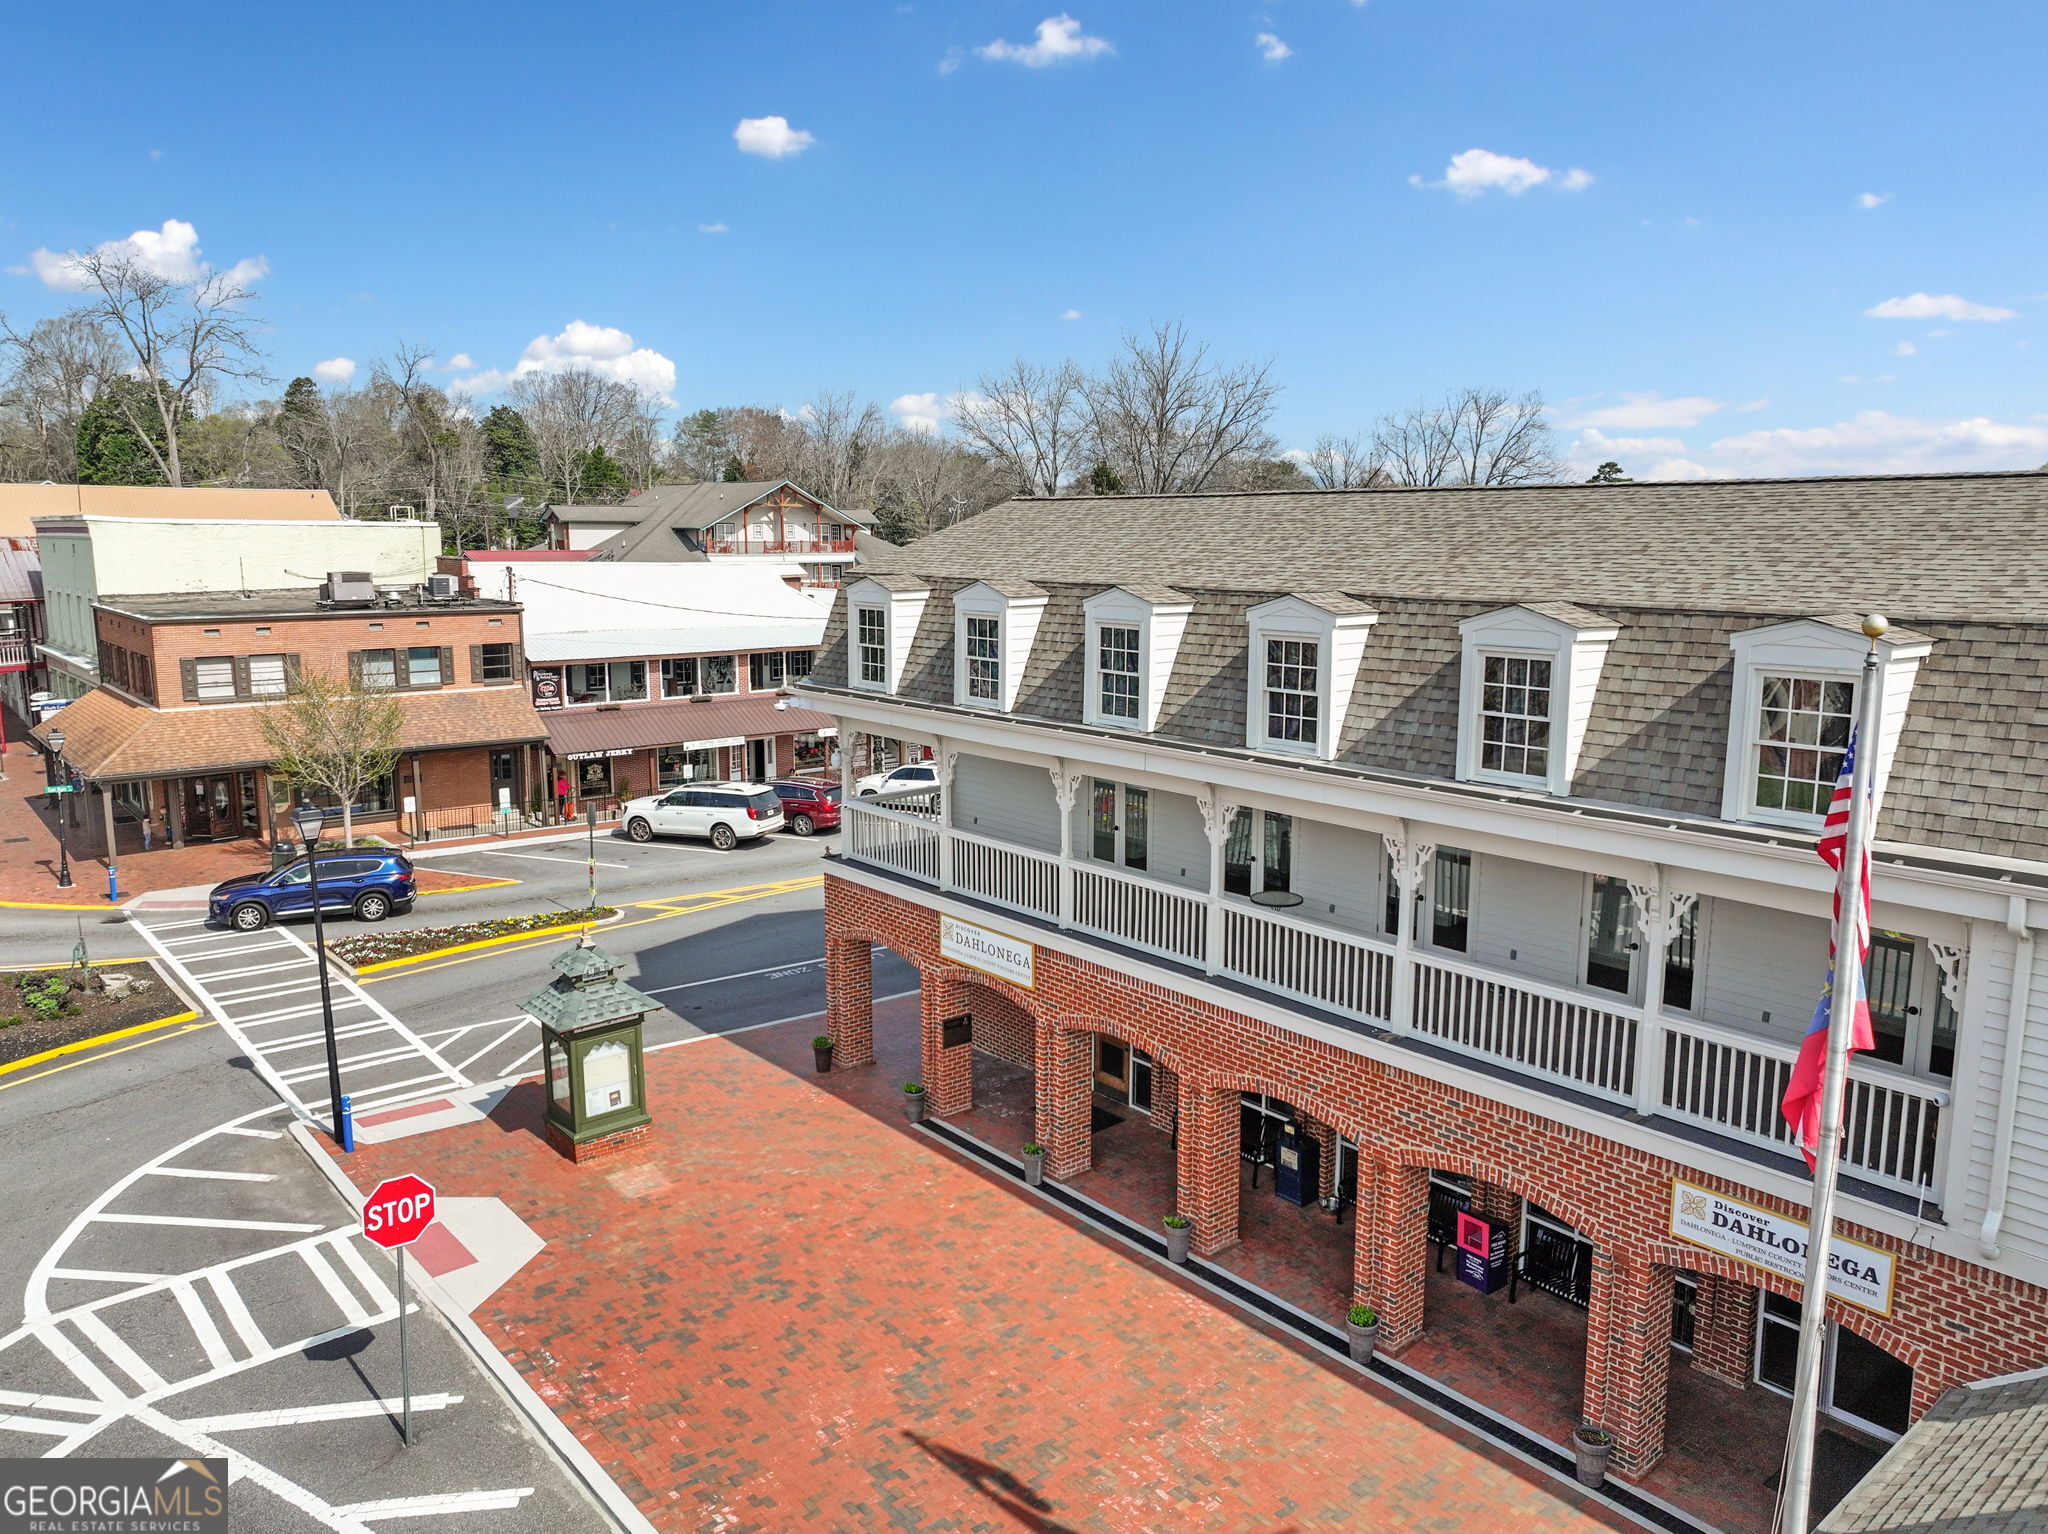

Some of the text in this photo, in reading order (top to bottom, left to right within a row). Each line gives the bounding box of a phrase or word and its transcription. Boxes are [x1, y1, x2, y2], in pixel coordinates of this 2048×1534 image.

[567, 748, 634, 760] OUTLAW JERKY
[955, 924, 981, 936] DISCOVER
[956, 932, 1031, 969] DAHLONEGA
[368, 1193, 430, 1231] STOP
[1714, 1200, 1770, 1227] Discover
[1680, 1218, 1726, 1242] DAHLONEGA
[1732, 1238, 1767, 1256] LUMPKIN
[1768, 1252, 1802, 1269] COUNTY
[1844, 1279, 1878, 1297] CENTER
[1735, 1248, 1763, 1264] PUBLIC
